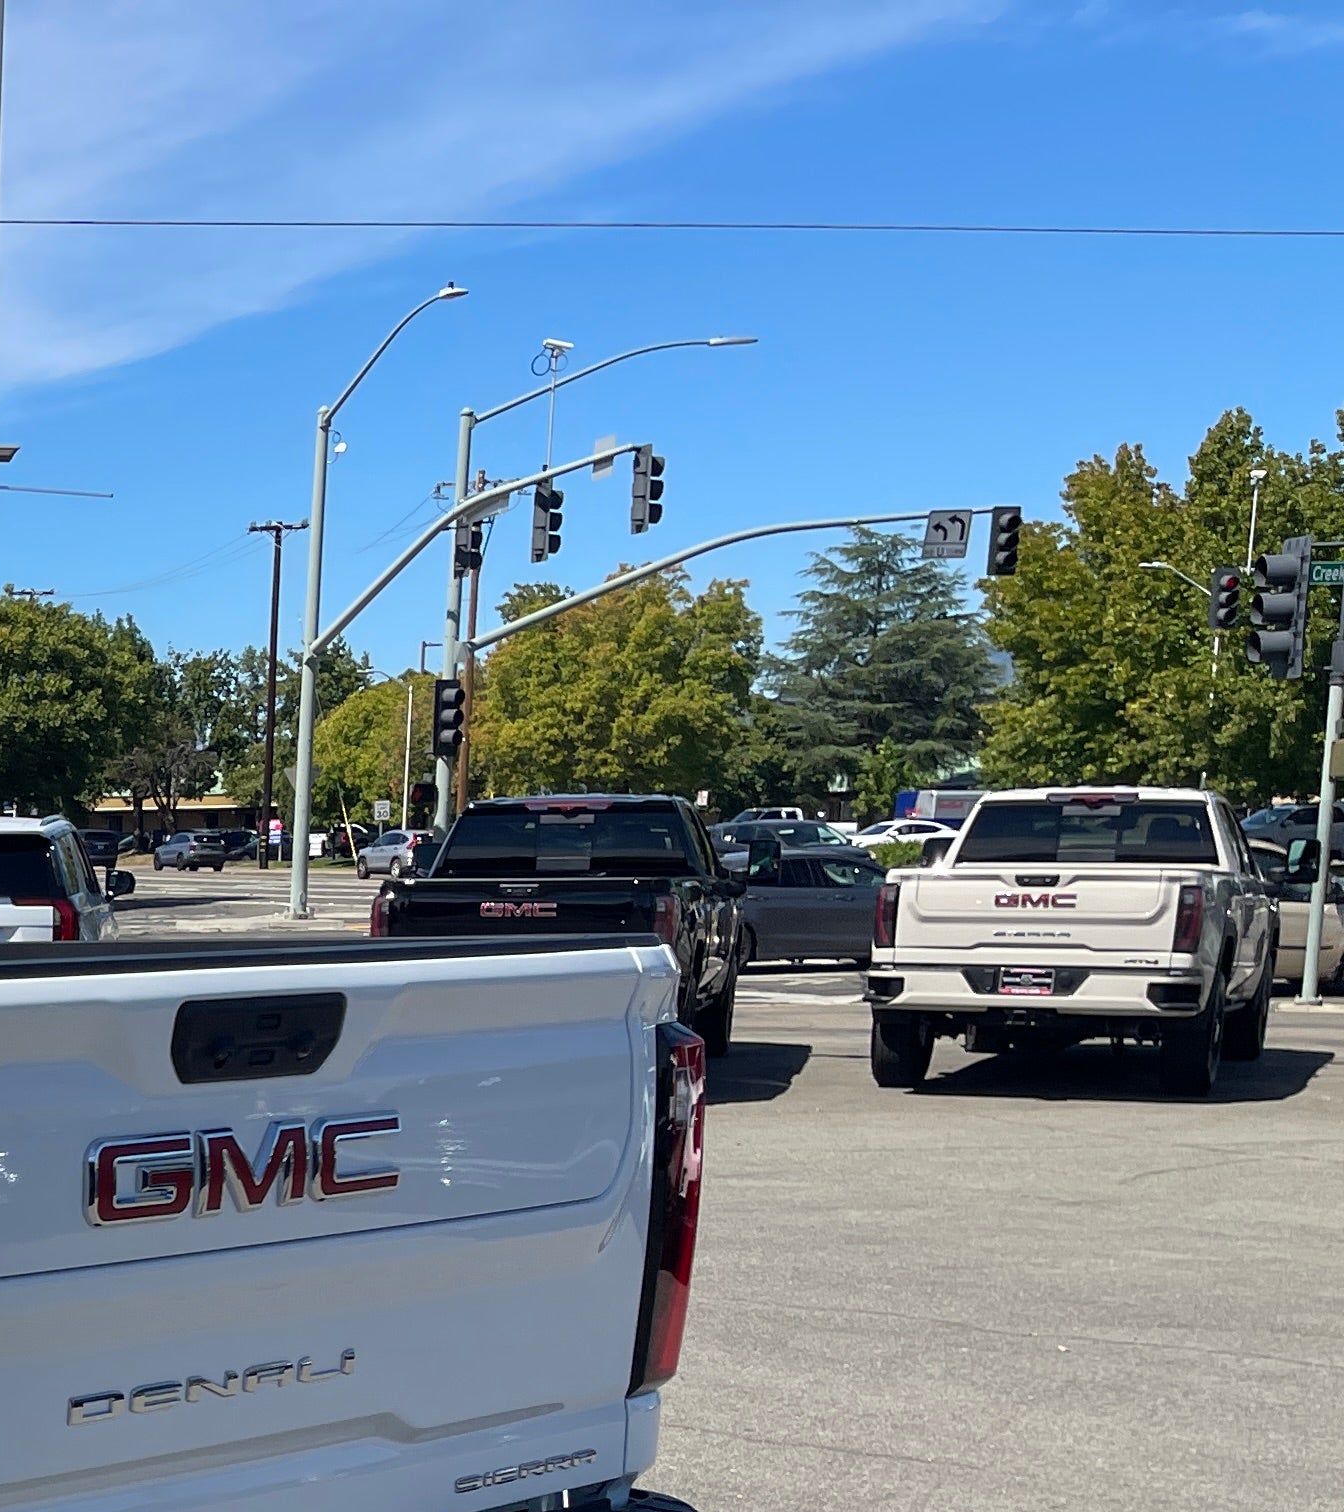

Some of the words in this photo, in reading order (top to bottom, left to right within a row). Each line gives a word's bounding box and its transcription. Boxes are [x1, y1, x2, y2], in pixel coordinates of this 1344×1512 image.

[480, 902, 558, 917] GMC
[995, 893, 1078, 908] GMC
[83, 1109, 401, 1227] GMC
[67, 1347, 356, 1426] DENALI
[455, 1448, 597, 1494] SIERRA
